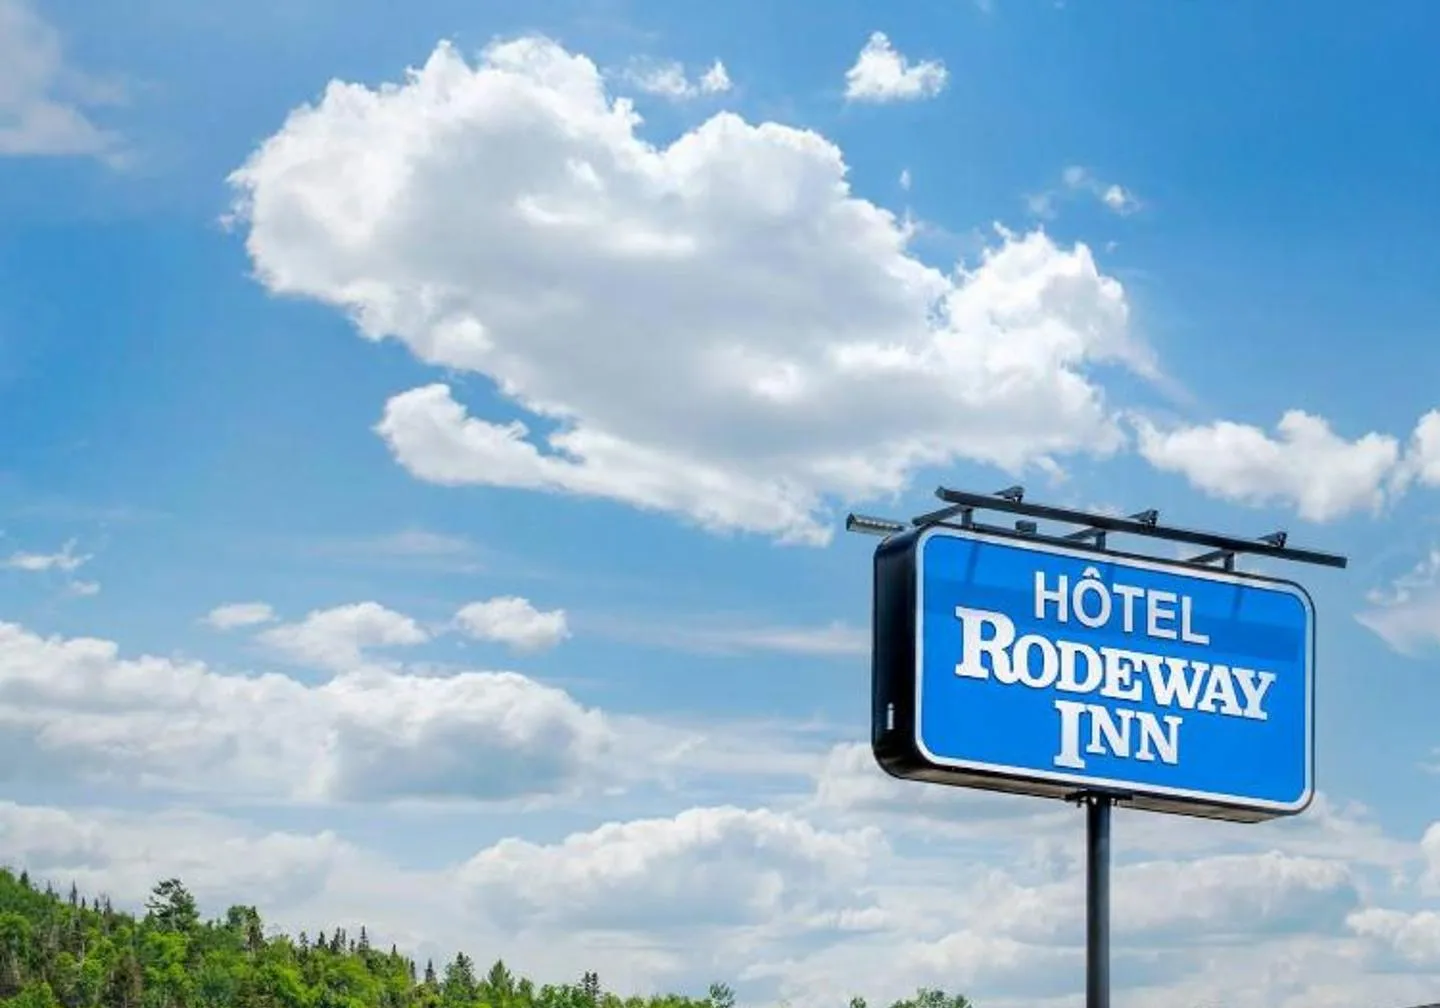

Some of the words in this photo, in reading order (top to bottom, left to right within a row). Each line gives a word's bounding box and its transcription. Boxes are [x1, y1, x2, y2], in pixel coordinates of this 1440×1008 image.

[1034, 567, 1210, 645] HÔTEL
[954, 606, 1277, 721] RODEWAY
[1053, 699, 1183, 769] INN
